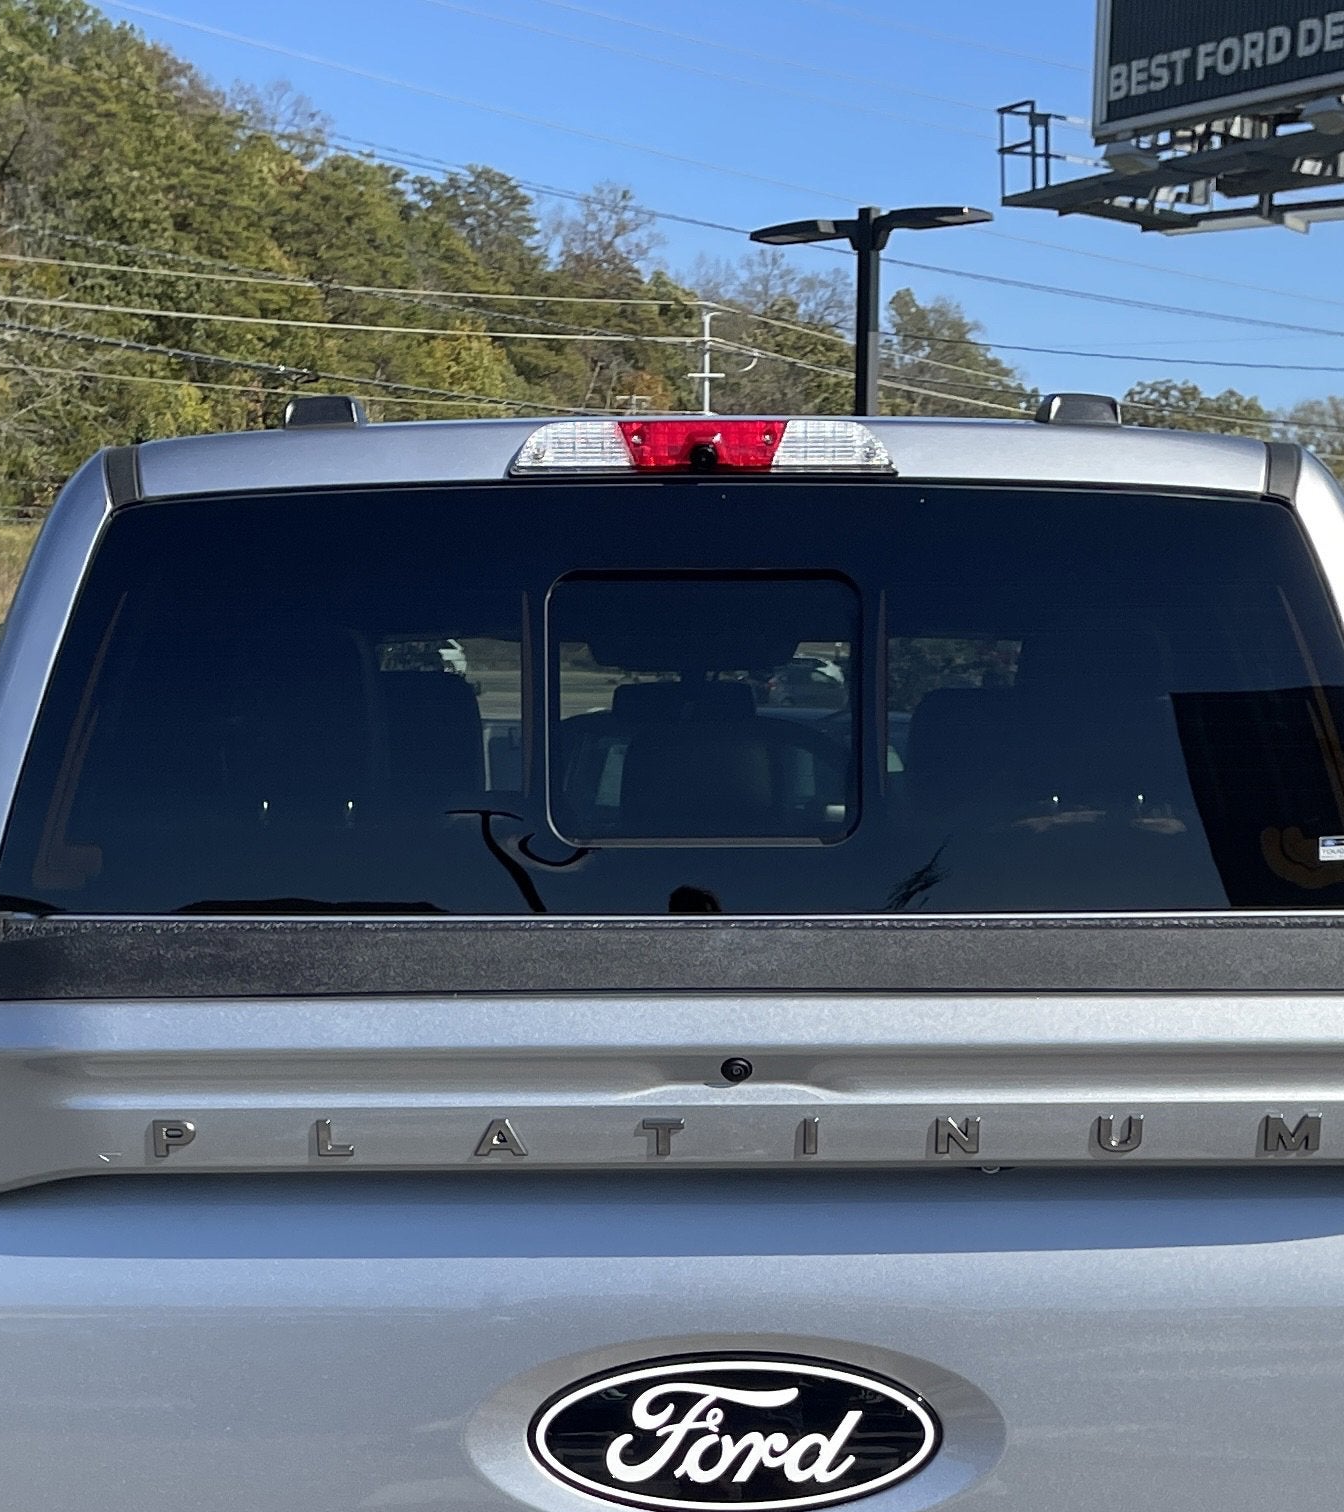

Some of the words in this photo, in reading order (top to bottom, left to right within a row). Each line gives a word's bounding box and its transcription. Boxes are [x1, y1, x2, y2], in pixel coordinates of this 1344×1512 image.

[1109, 47, 1192, 101] BEST
[1195, 25, 1291, 81] FORD
[152, 1112, 1322, 1157] PLATINUM
[605, 1382, 863, 1483] Ford
